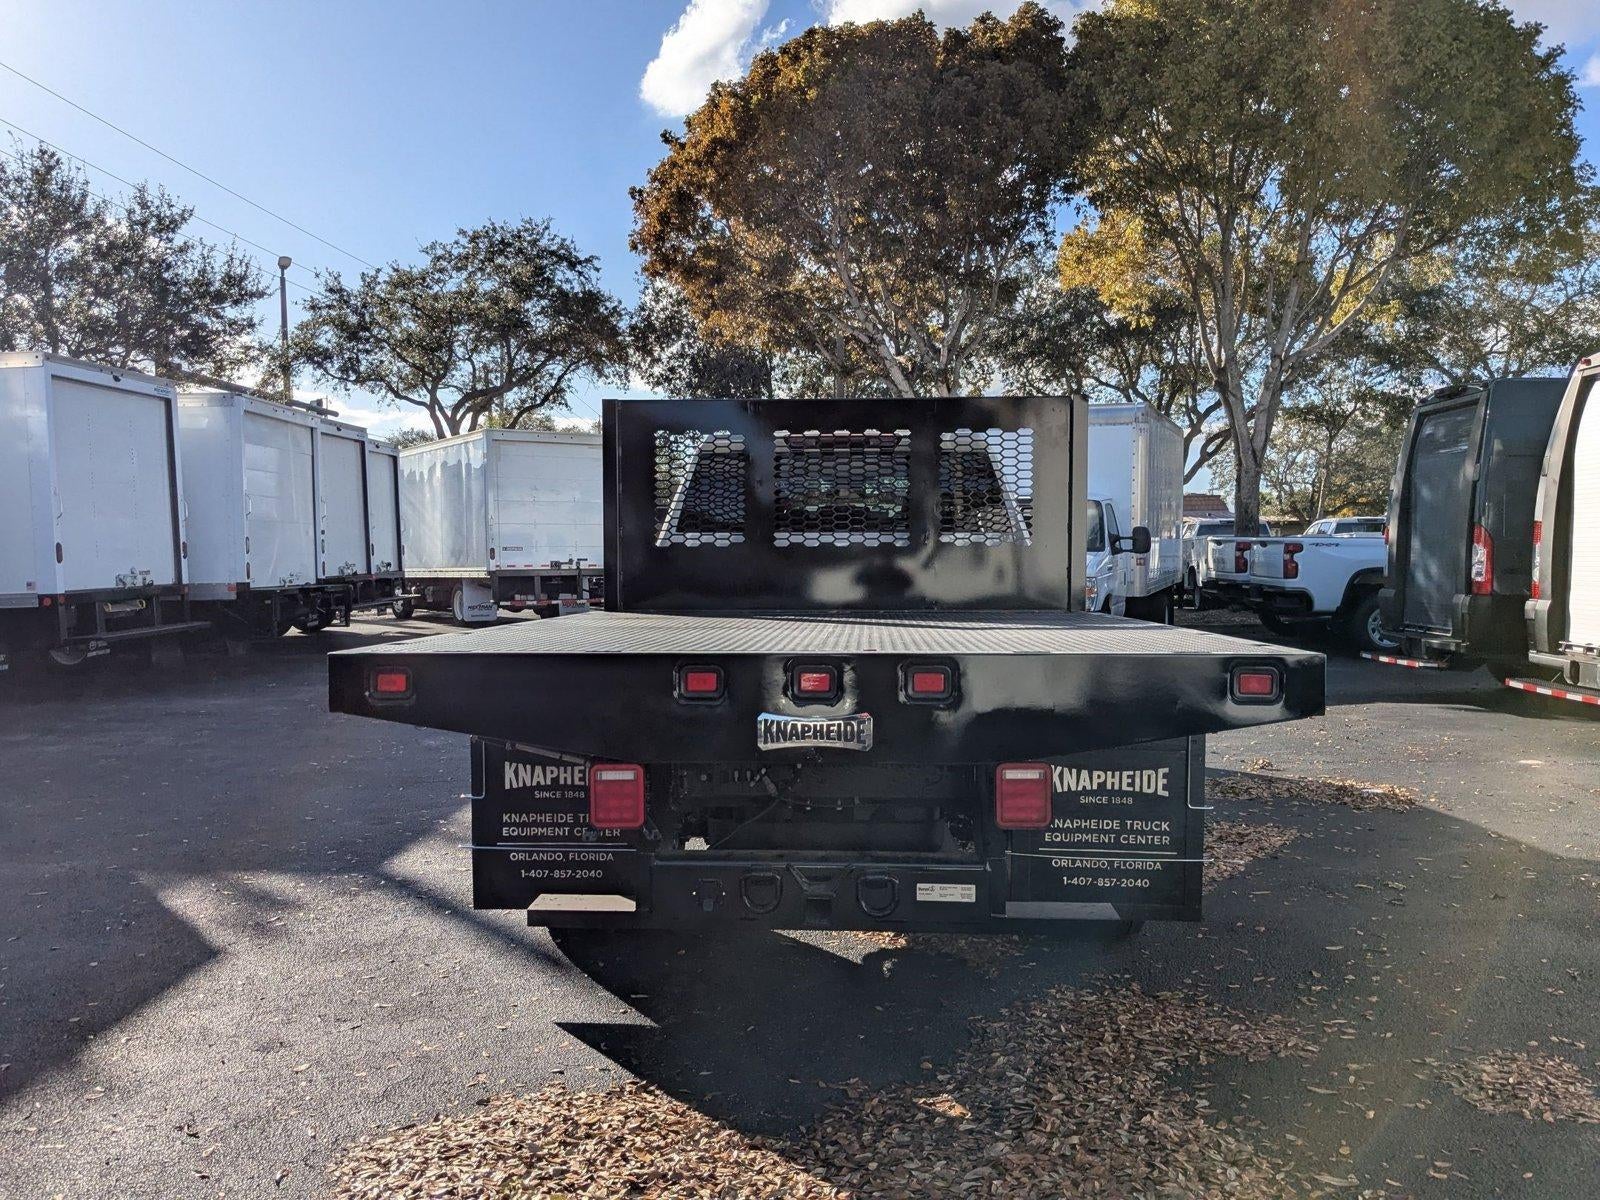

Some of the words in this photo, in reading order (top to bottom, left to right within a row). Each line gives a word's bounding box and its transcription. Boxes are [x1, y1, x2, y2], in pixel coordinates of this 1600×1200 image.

[763, 718, 867, 744] KNAPHEIDE
[504, 761, 589, 790] KNAPHEI
[1050, 765, 1169, 797] KNAPHEIDE
[534, 791, 561, 799] SINCE
[564, 791, 585, 799] 1848
[1079, 795, 1108, 804] SINCE
[1111, 796, 1133, 805] 1848
[502, 813, 574, 823] KNAPHEIDE
[1050, 818, 1121, 830] NAPHEIDE
[1125, 820, 1170, 831] TRUCK
[502, 827, 570, 836] EQUIPMENT
[1044, 832, 1116, 843] EQUIPMENT
[1120, 834, 1170, 845] CENTER
[509, 852, 566, 862] ORLANDO,
[568, 853, 614, 861] FLORIDA
[1051, 859, 1110, 870] ORLANDO,
[1114, 860, 1162, 870] FLORIDA
[520, 869, 603, 878] 1-407-857-2040
[1063, 876, 1150, 888] 1-407-857-2040
